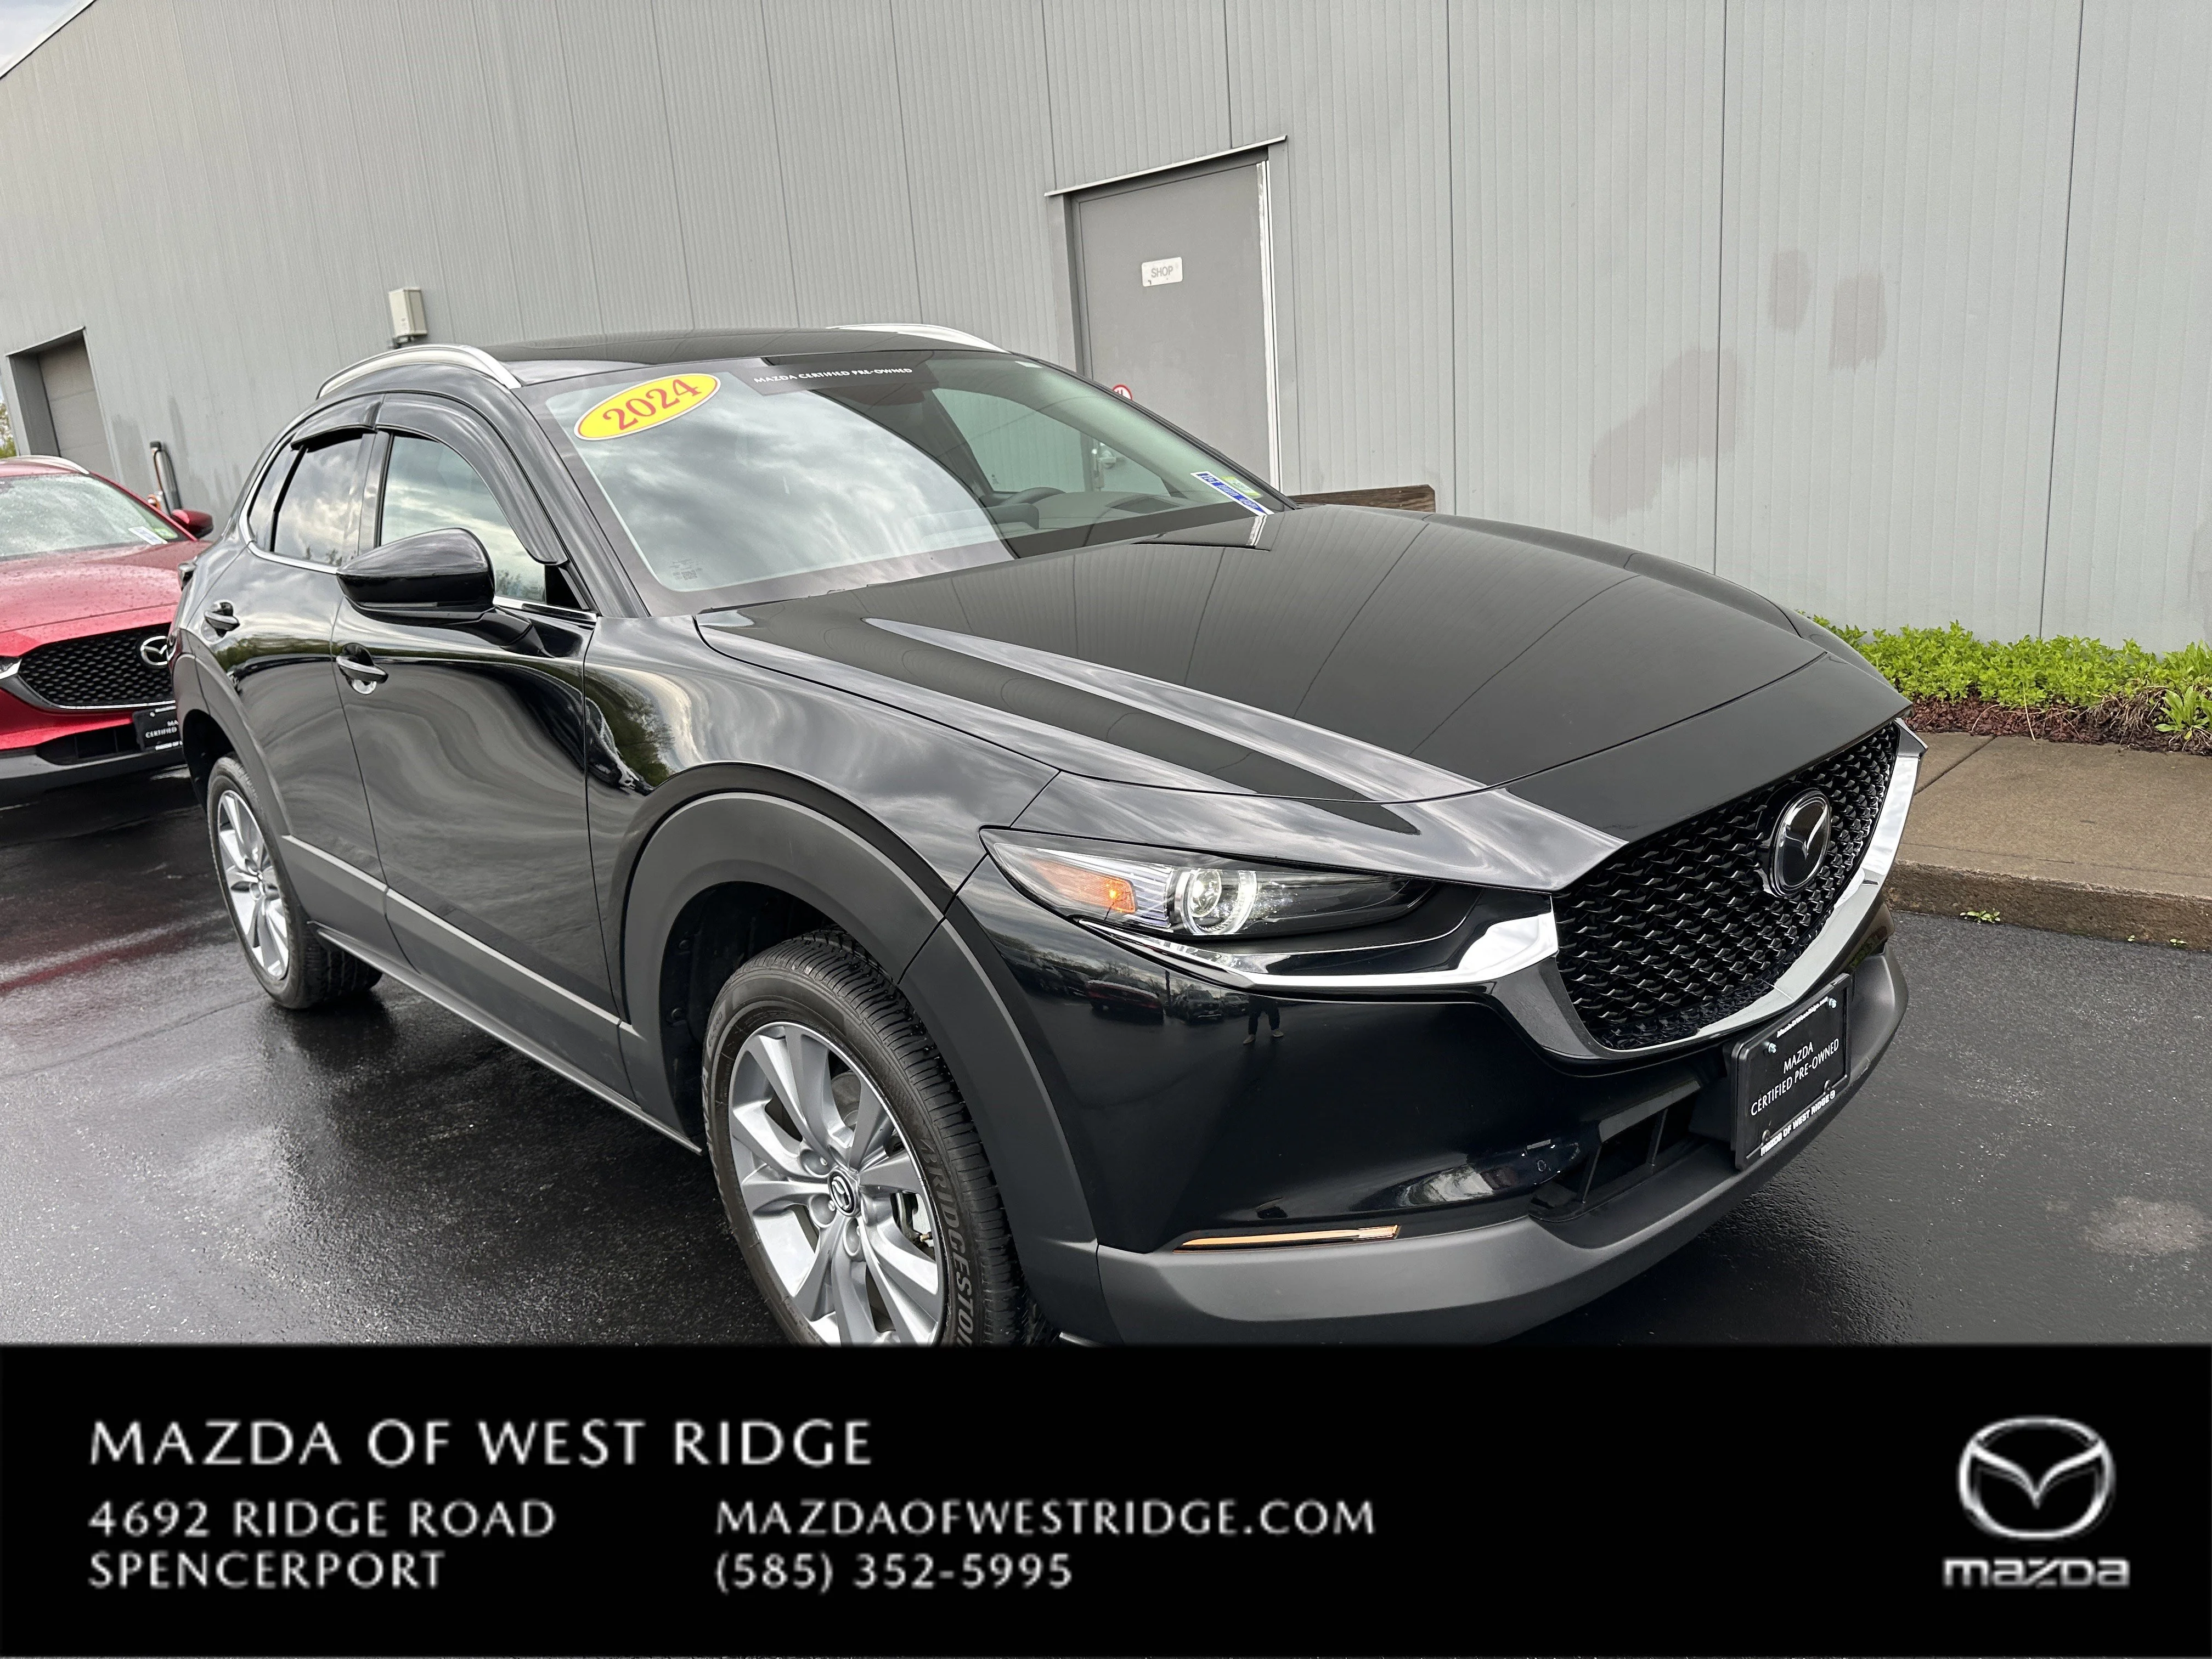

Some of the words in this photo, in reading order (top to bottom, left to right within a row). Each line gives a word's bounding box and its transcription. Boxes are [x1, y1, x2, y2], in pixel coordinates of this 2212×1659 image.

[1151, 266, 1173, 278] SHOP
[754, 374, 798, 383] MAZDA
[798, 370, 850, 379] CERTIFIED
[602, 379, 702, 431] 2024
[1783, 1042, 1814, 1074] MAZDA
[1751, 1076, 1793, 1116] CERTIFIED
[1794, 1038, 1839, 1084] PRE-OWNED
[1783, 1125, 1792, 1137] OF
[1792, 1109, 1810, 1130] WEST
[1811, 1095, 1830, 1115] RIDGE
